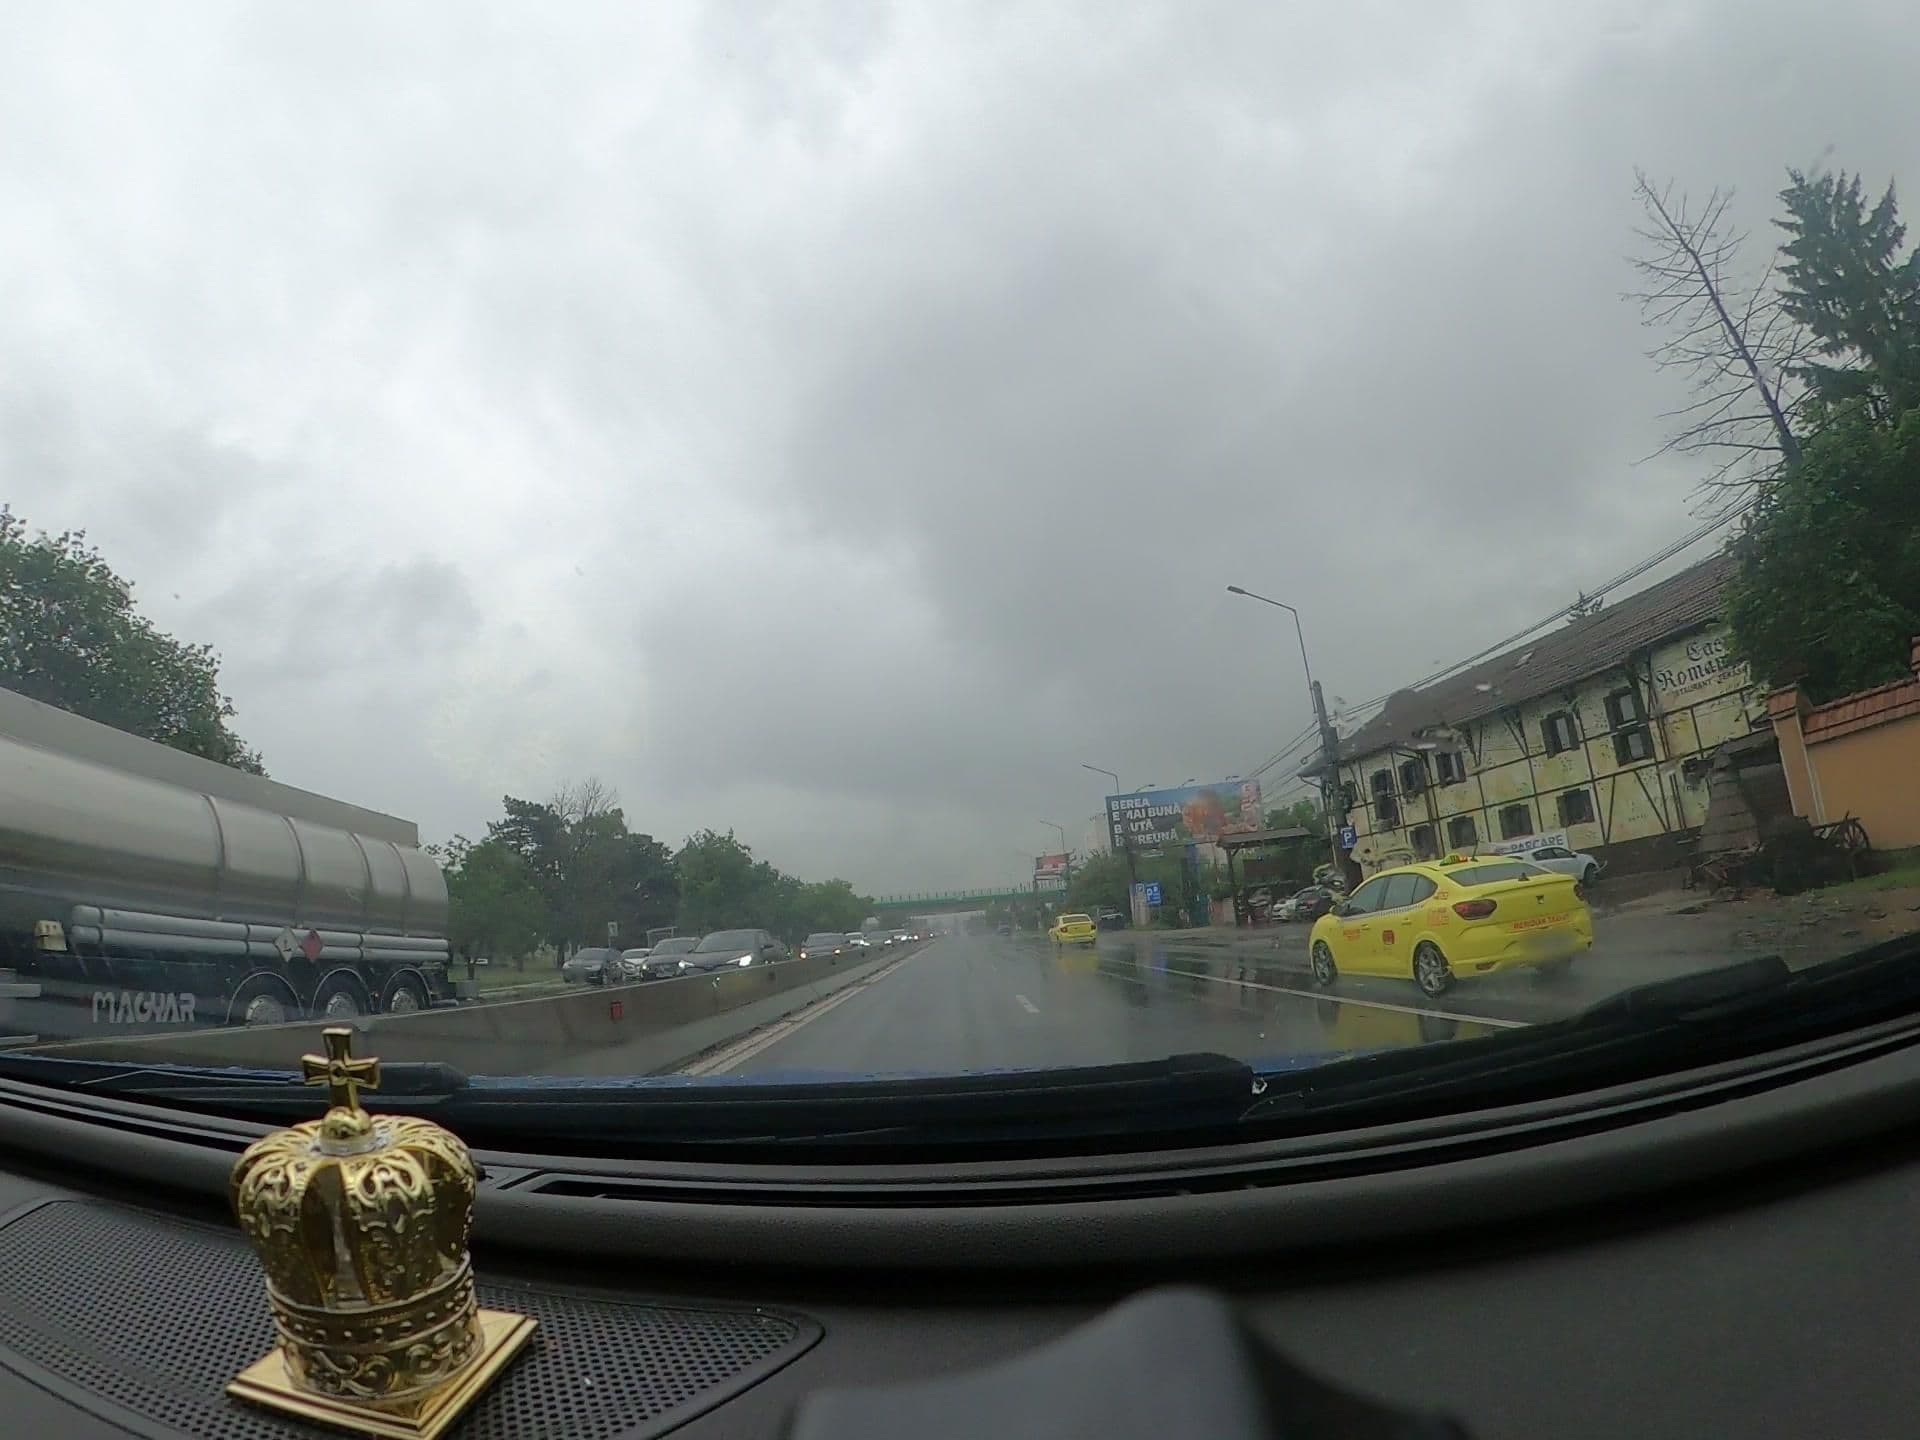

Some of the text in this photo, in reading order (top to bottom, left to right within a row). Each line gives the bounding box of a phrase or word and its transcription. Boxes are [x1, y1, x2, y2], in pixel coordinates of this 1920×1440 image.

[1111, 798, 1151, 811] BEREA
[1112, 812, 1121, 822] E
[1511, 834, 1564, 850] PARCARE
[93, 991, 195, 1024] MAGYAR
